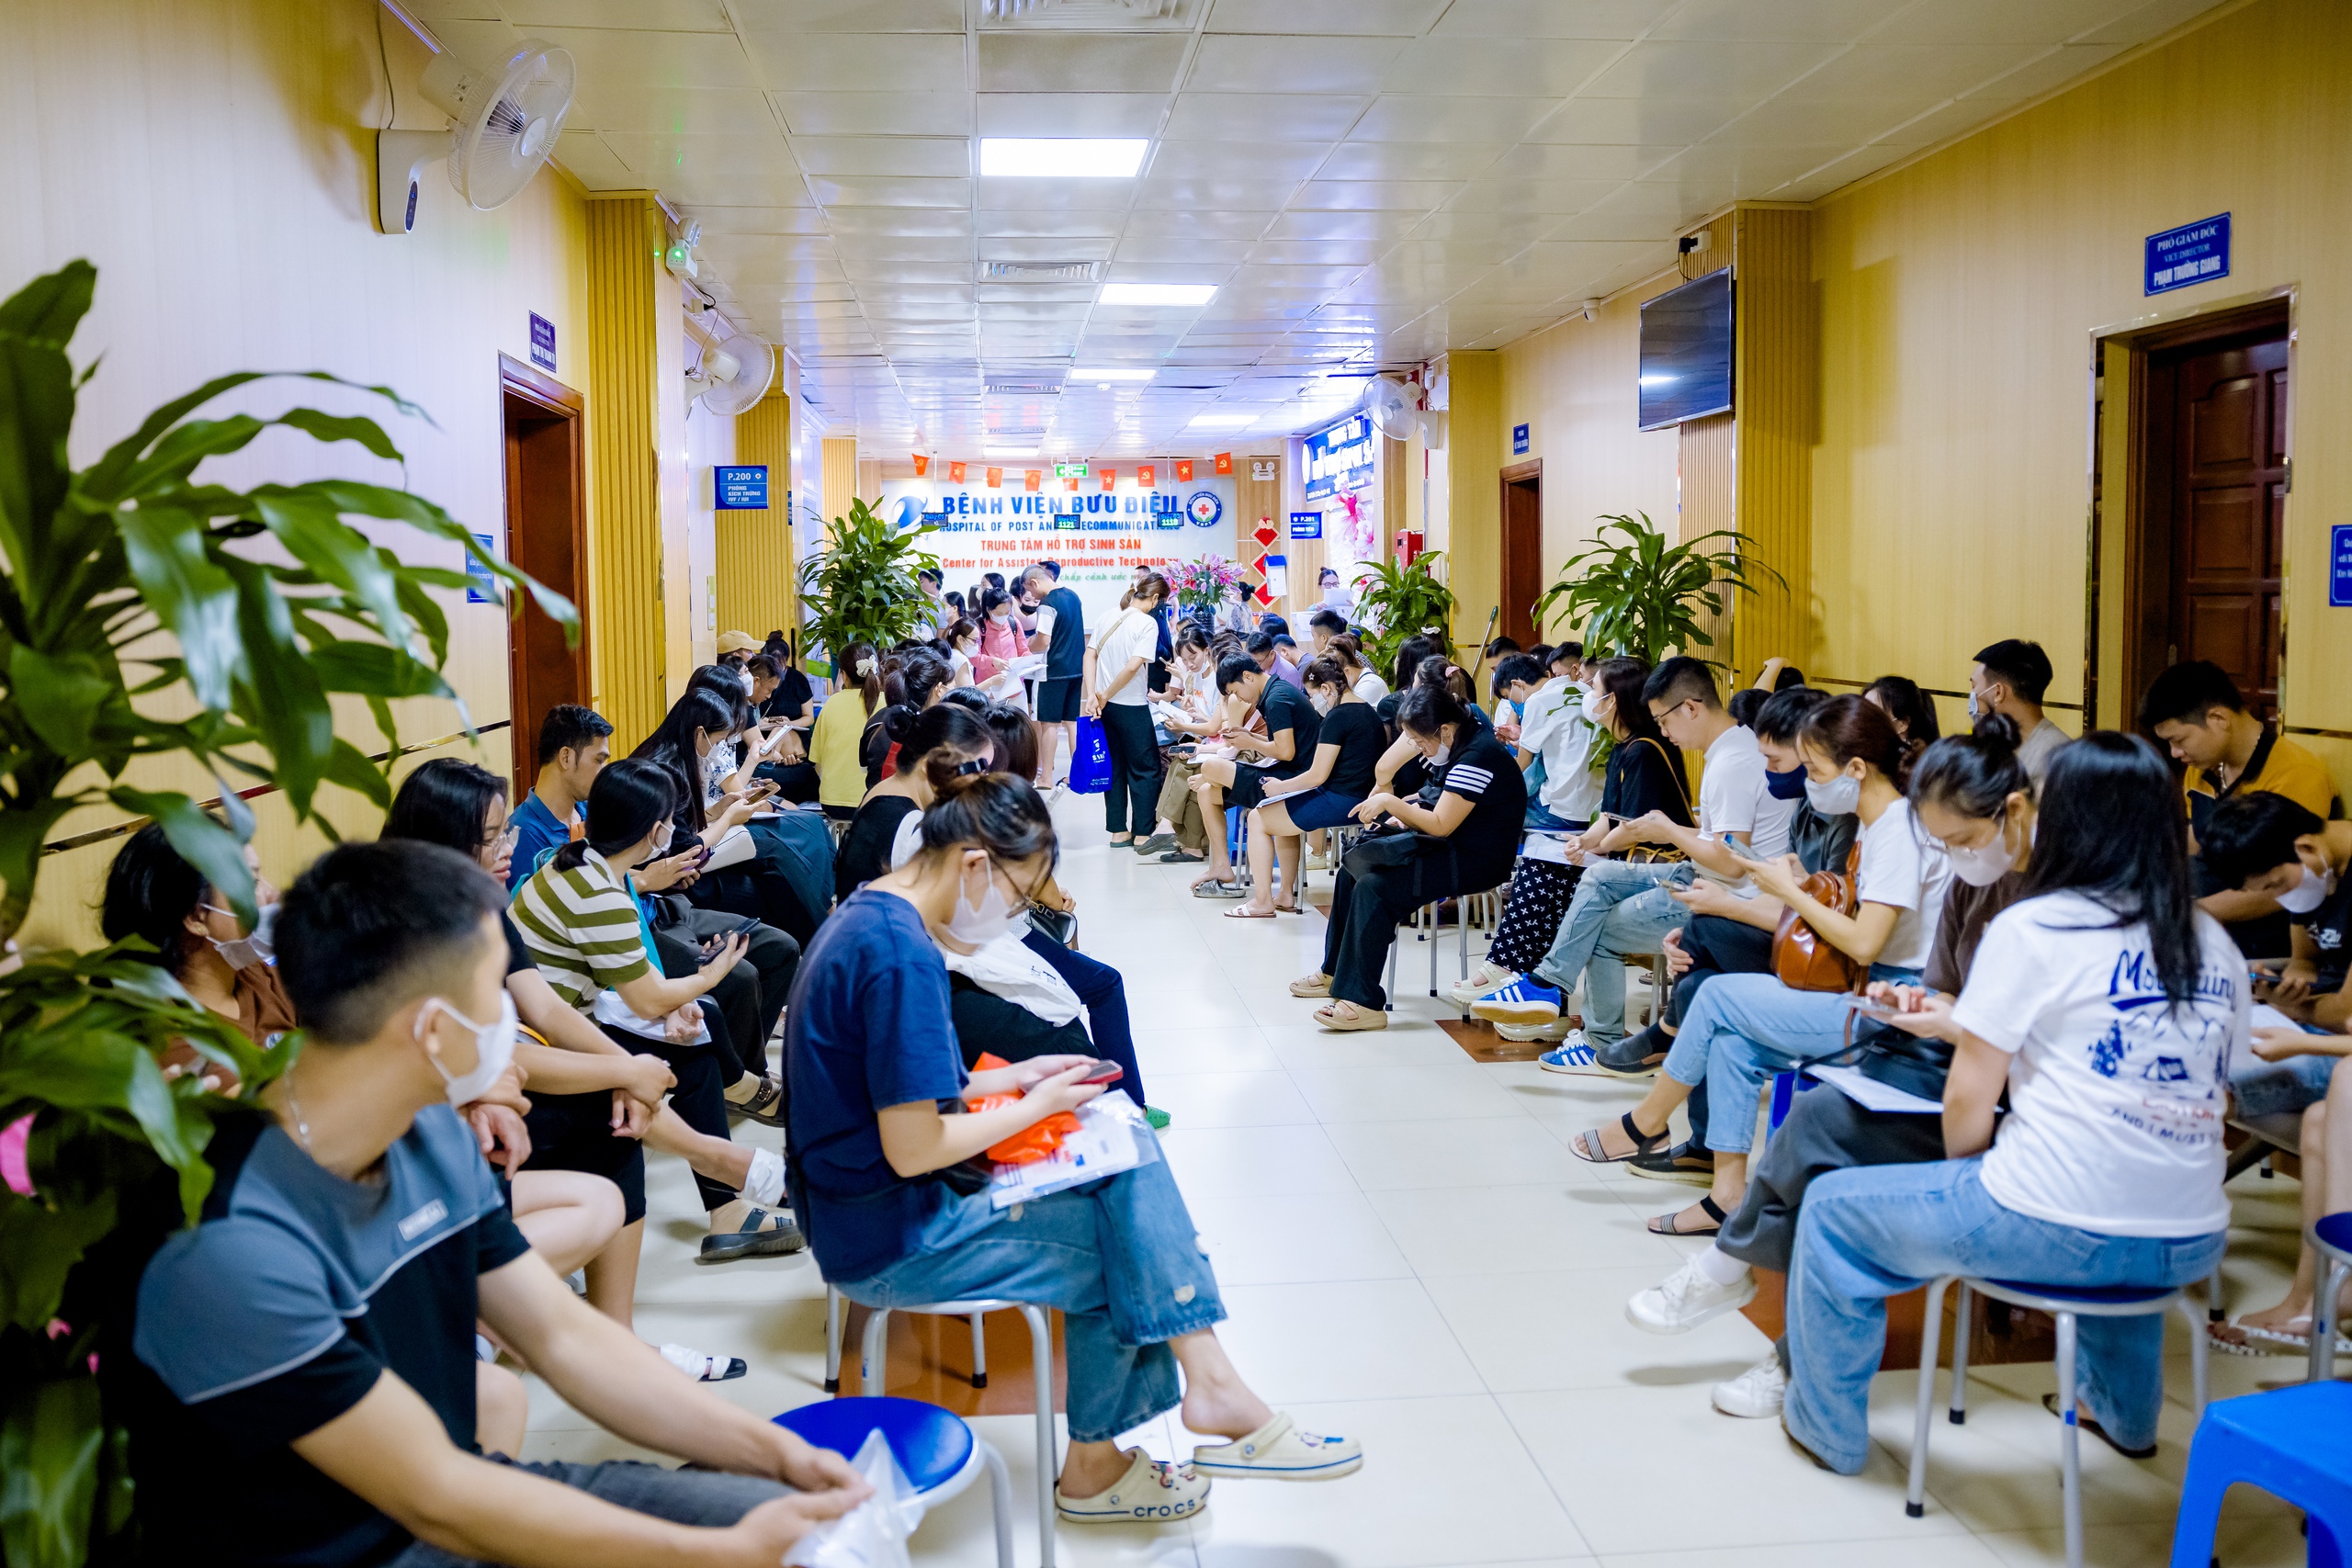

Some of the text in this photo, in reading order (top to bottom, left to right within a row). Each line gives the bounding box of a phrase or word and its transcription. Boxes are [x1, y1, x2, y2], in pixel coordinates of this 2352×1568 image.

[728, 472, 752, 480] P.200
[943, 491, 1003, 519] BỆNH
[1011, 491, 1063, 519] VIỆN
[1071, 493, 1117, 513] BƯU
[990, 522, 1002, 531] OF
[1009, 521, 1034, 531] POST
[980, 533, 1142, 553] TRUNG TÂM HỖ TRỢ SINH SẢN
[943, 558, 976, 568] Center
[980, 558, 993, 568] for
[1134, 1499, 1195, 1517] crocs
